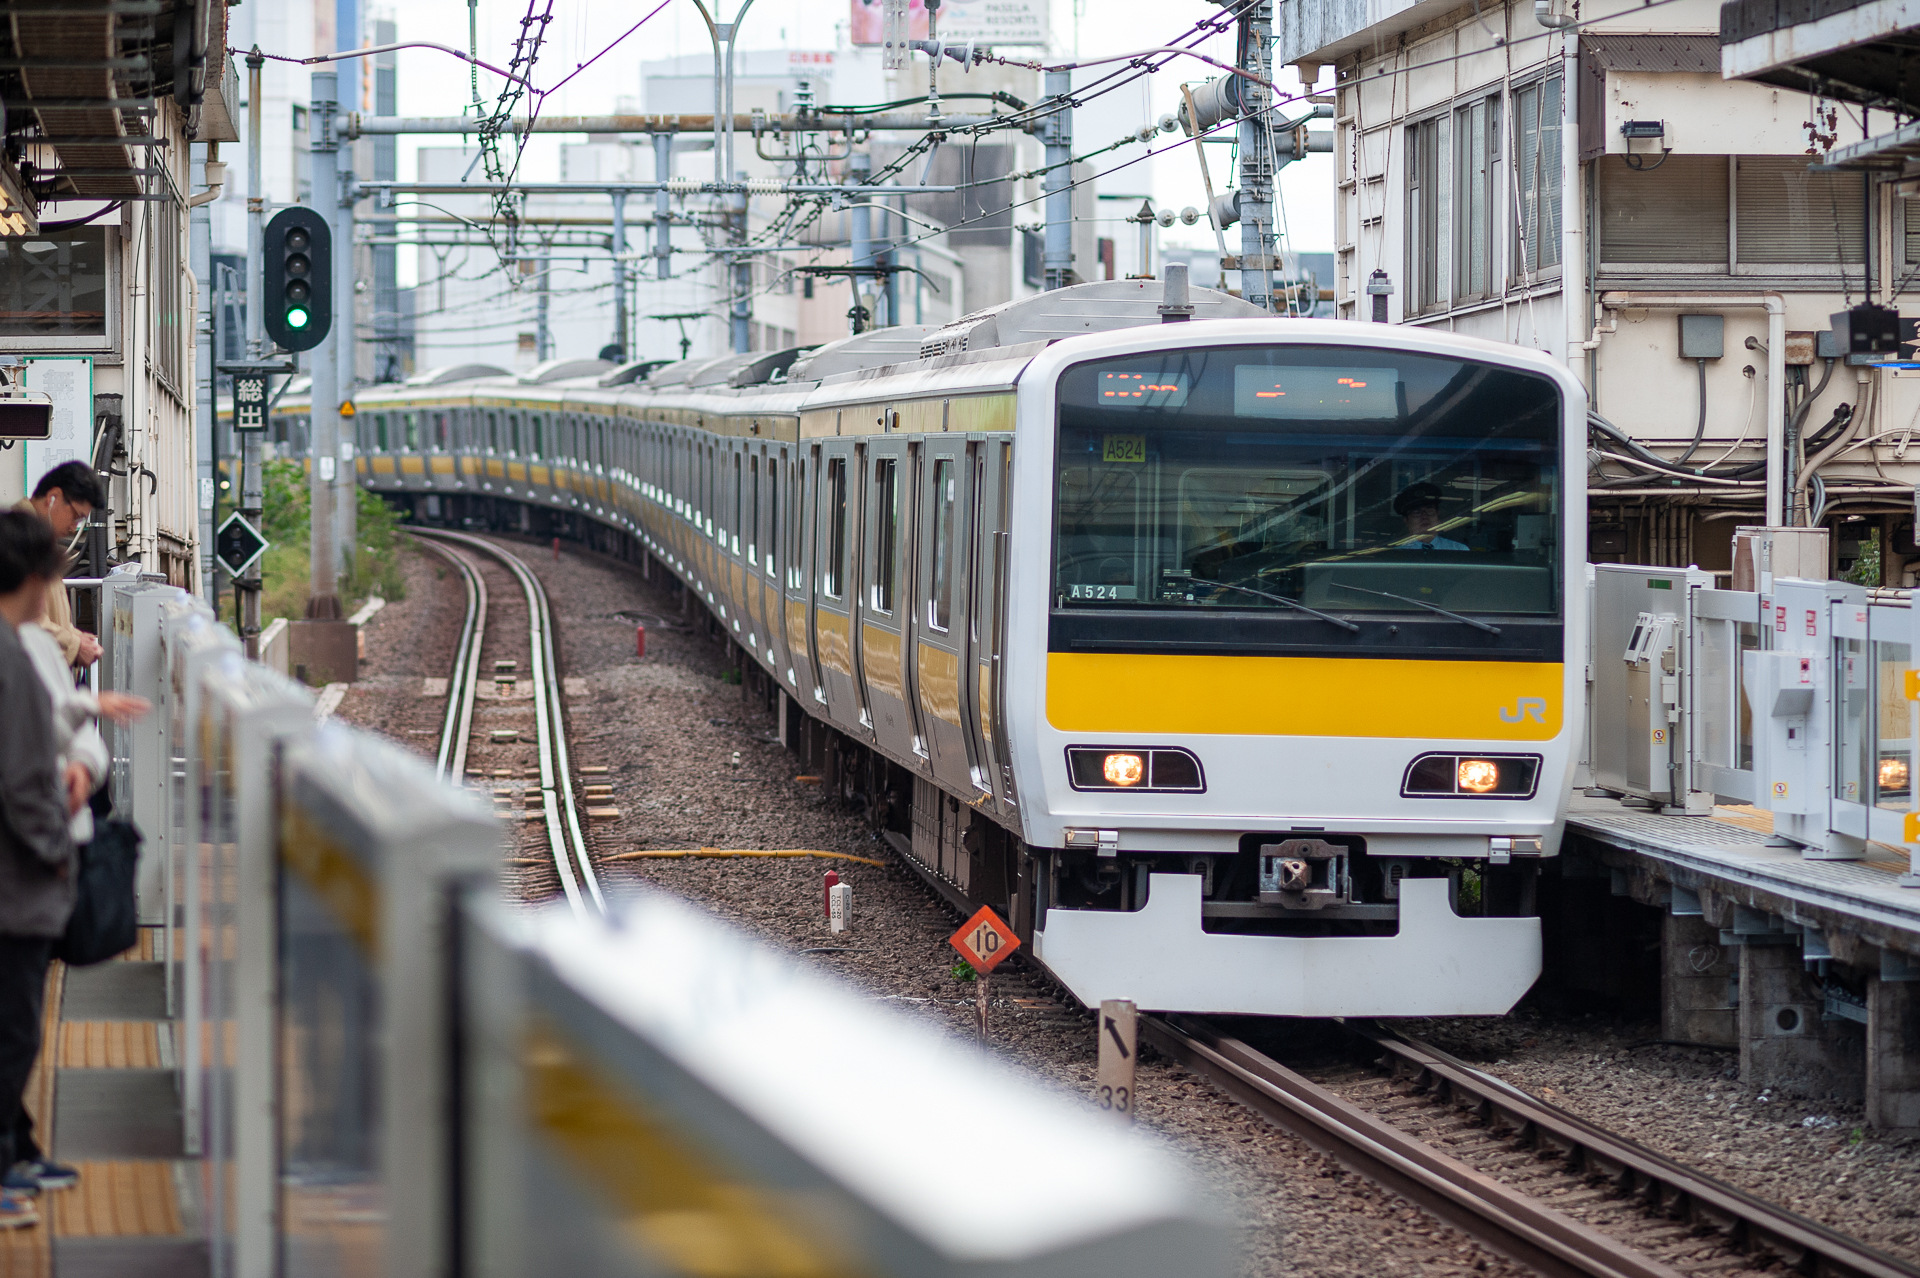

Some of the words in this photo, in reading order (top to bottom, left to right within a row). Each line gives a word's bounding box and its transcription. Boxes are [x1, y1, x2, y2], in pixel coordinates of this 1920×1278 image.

[985, 15, 1039, 25] RESORTS
[239, 379, 264, 428] 総出
[1106, 440, 1143, 460] A524
[1071, 585, 1117, 599] A524
[1499, 696, 1547, 724] JR
[976, 929, 998, 954] 10
[1099, 1085, 1130, 1112] 33
